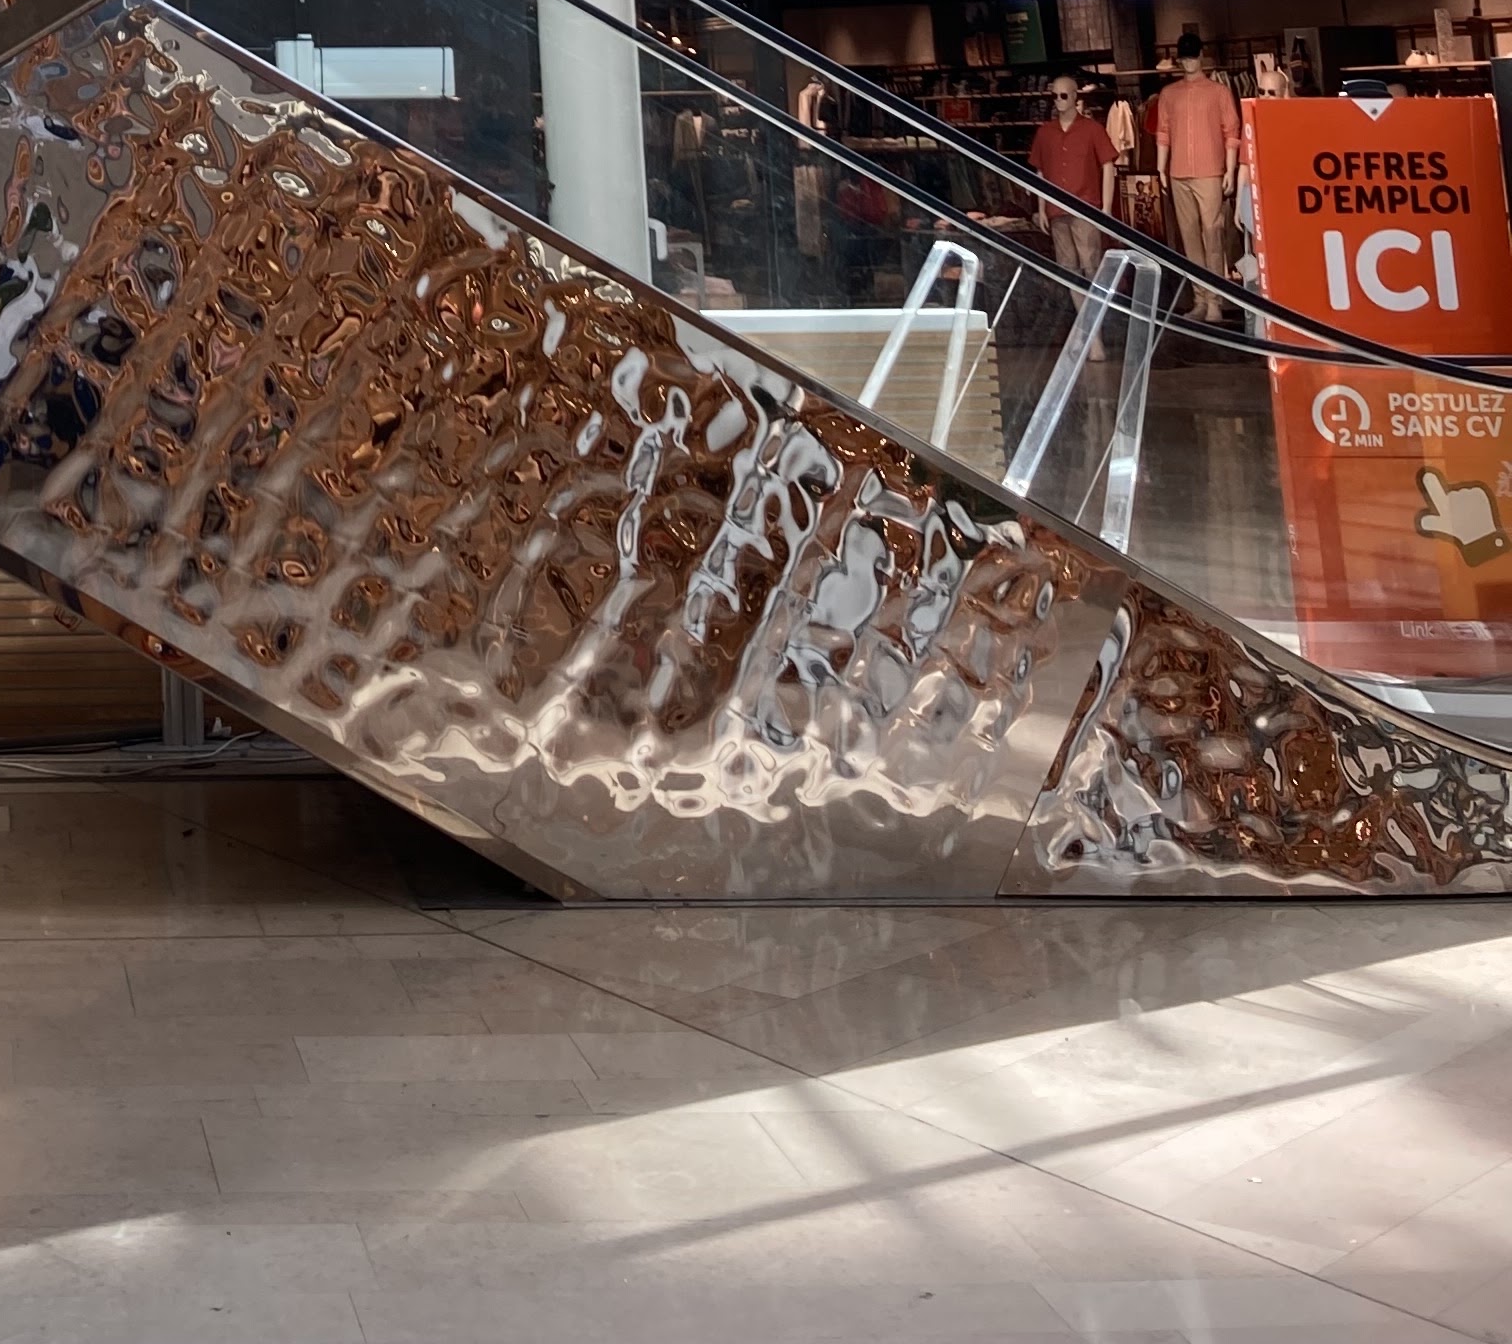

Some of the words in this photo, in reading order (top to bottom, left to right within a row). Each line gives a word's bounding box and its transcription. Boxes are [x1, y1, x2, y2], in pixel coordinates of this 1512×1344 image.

[1313, 151, 1448, 181] OFFRES
[1297, 185, 1471, 214] D'EMPLOI
[1323, 229, 1459, 311] ICI
[1388, 392, 1506, 412] POSTULEZ
[1338, 427, 1352, 447] 2
[1354, 434, 1384, 447] MIN
[1391, 414, 1460, 437] SANS
[1466, 415, 1502, 437] CV
